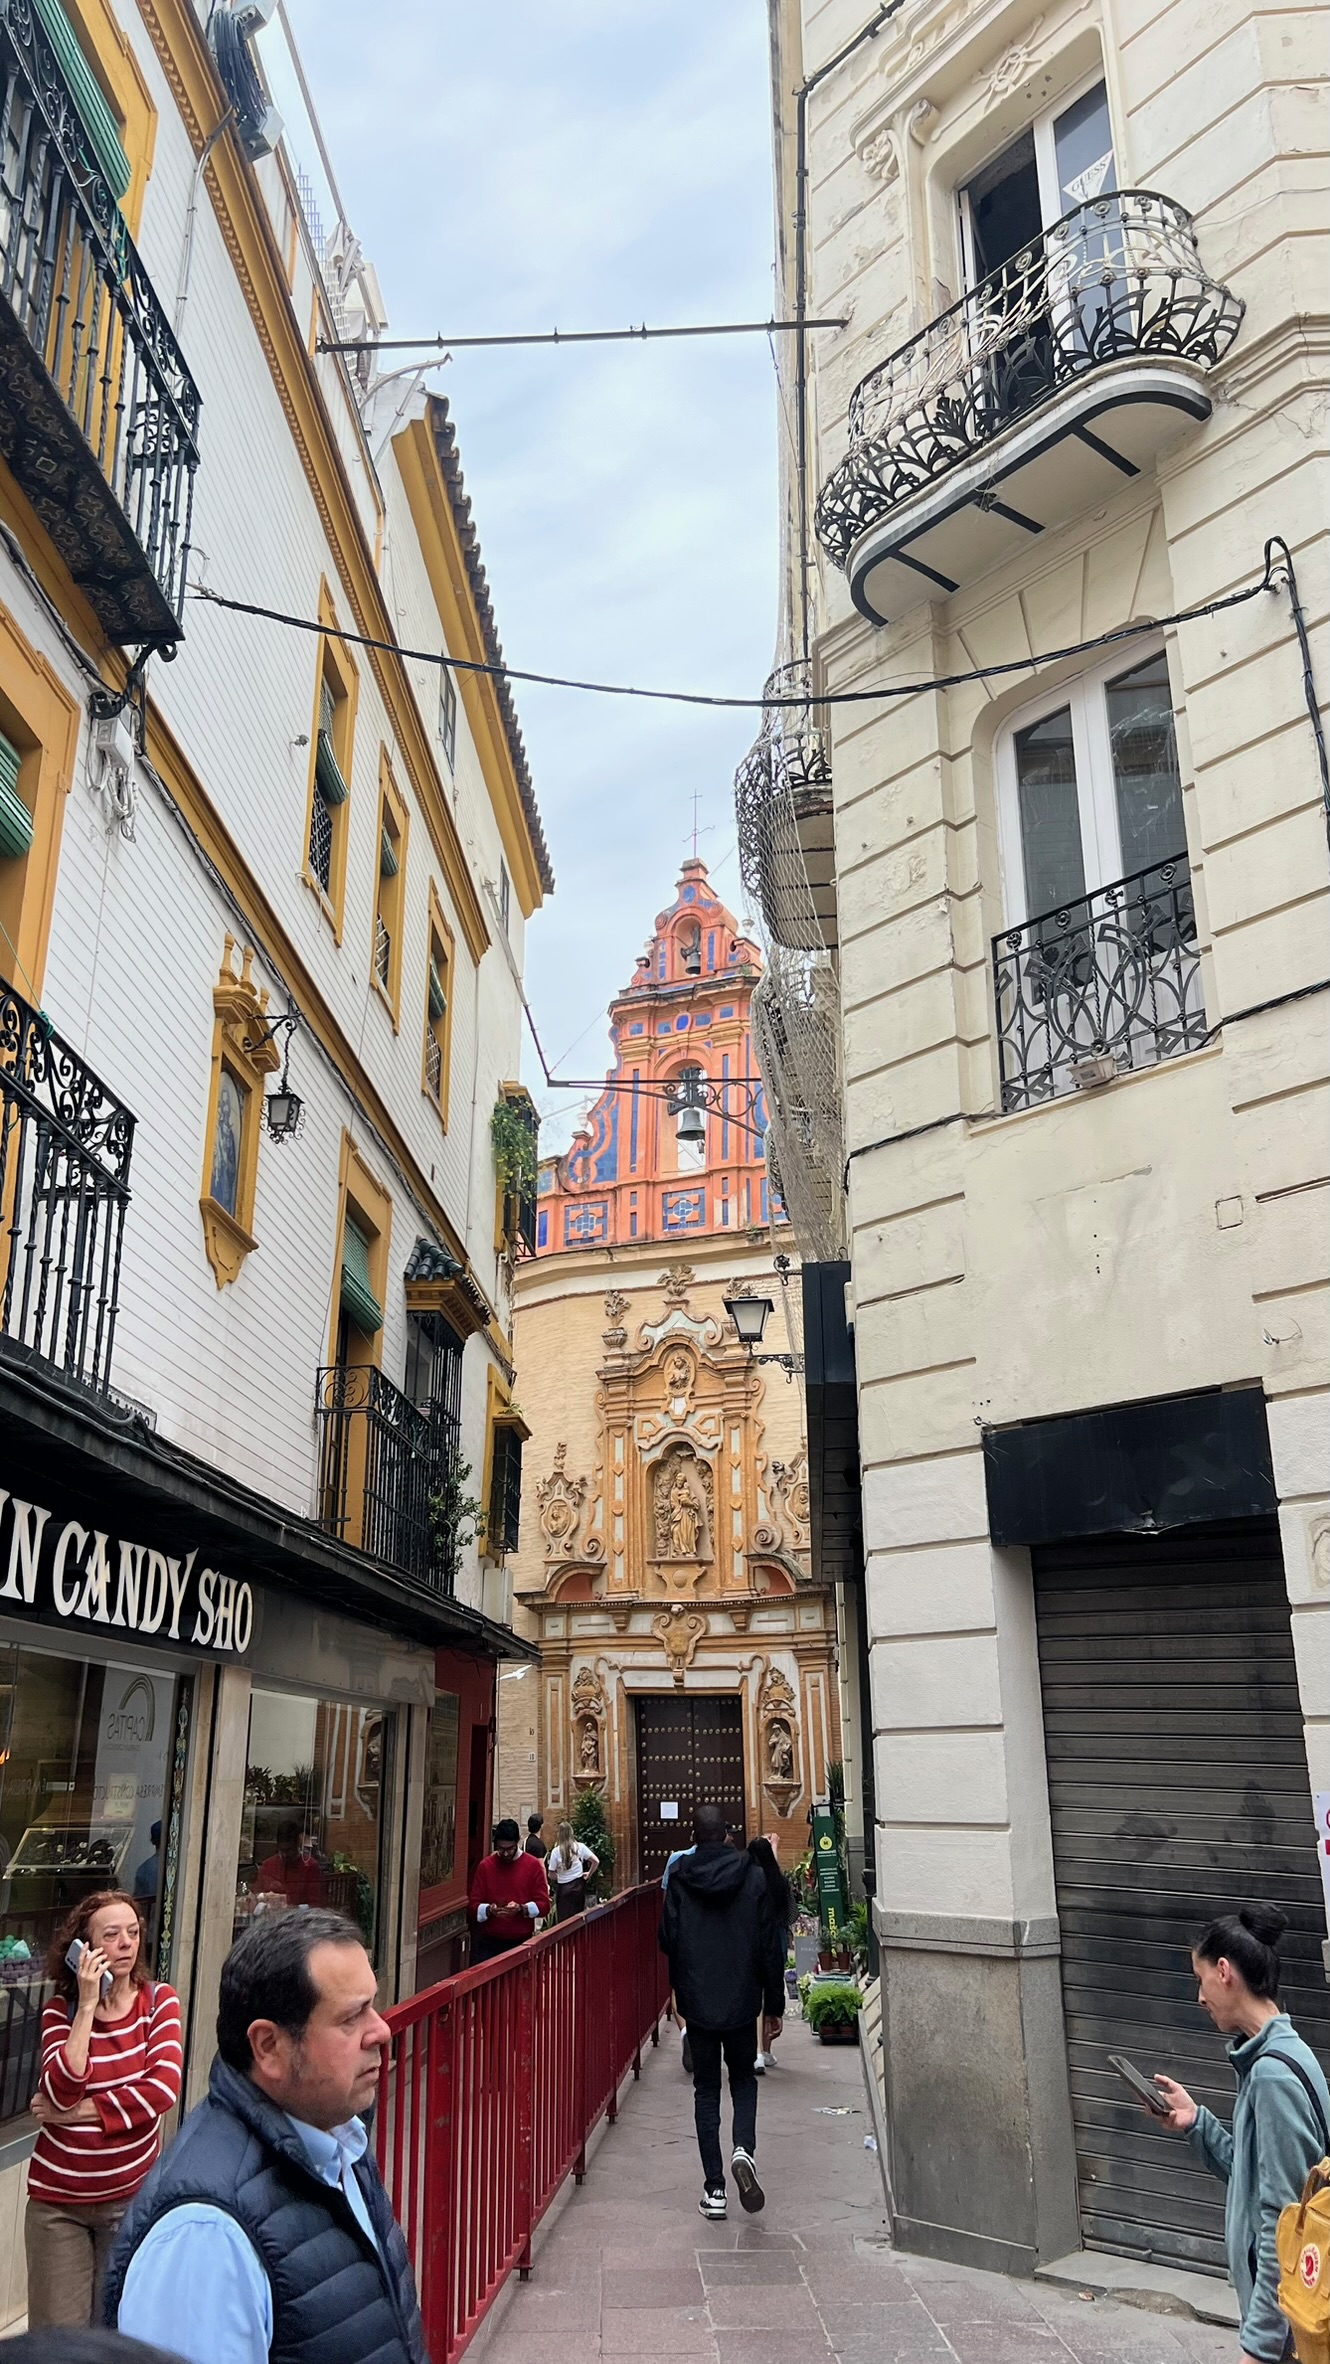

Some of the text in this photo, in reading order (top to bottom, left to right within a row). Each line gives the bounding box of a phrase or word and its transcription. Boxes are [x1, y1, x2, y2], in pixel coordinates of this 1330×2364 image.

[1071, 159, 1106, 192] GUESS
[0, 1487, 253, 1654] N CANDY SHO
